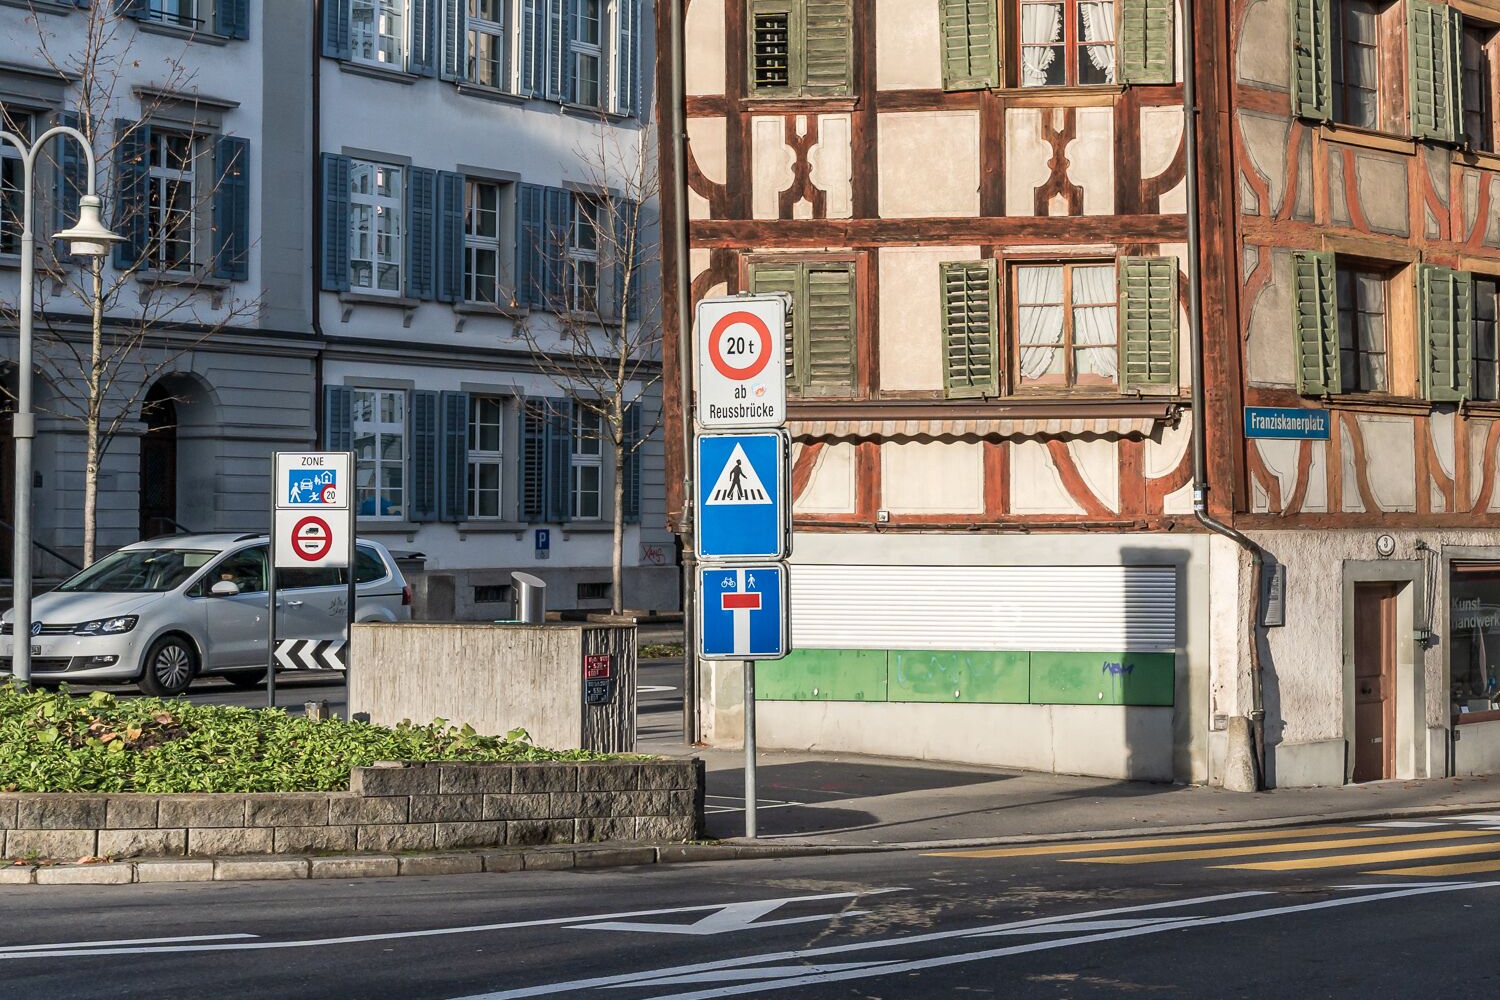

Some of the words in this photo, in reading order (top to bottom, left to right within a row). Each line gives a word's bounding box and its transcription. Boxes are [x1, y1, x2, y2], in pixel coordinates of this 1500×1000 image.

[727, 337, 745, 354] 20
[749, 340, 755, 354] t
[734, 384, 747, 399] ab
[709, 402, 774, 419] Reussbrücke
[1251, 412, 1325, 435] Franziskanerplatz
[301, 456, 324, 466] ZONE
[326, 491, 336, 500] 20
[1451, 597, 1481, 610] Kunst
